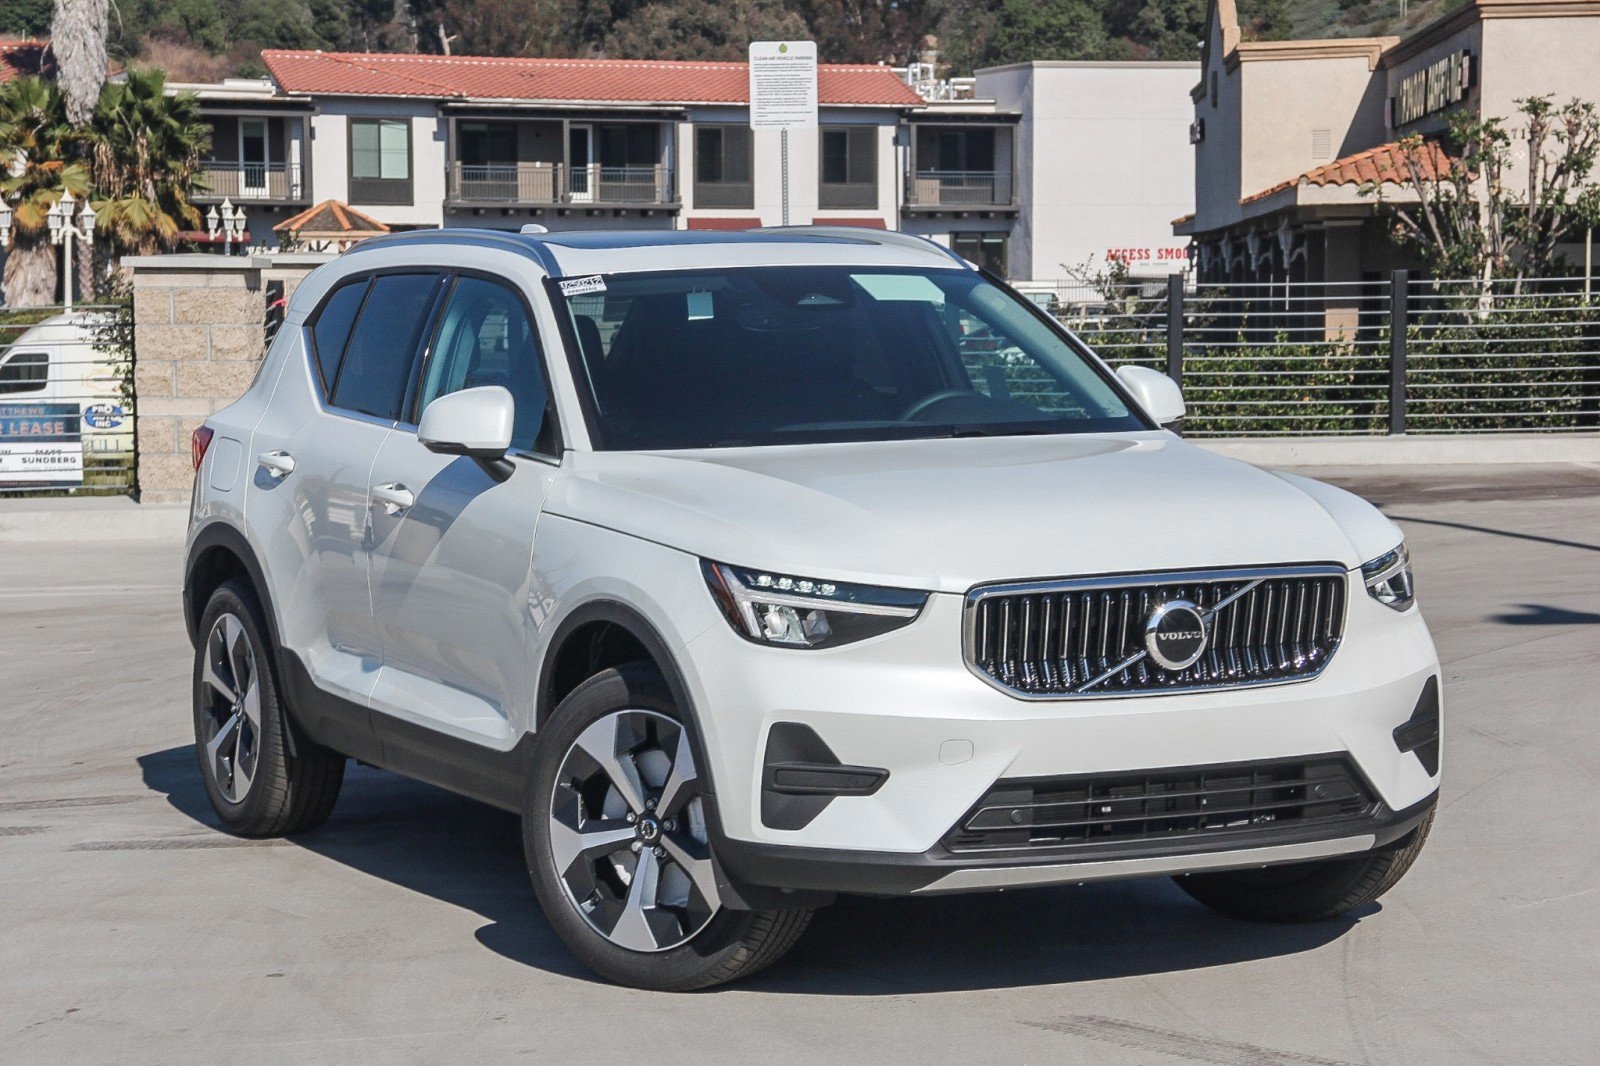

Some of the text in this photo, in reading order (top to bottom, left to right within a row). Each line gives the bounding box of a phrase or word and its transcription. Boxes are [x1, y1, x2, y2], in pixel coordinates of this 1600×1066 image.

[1107, 249, 1151, 260] ACCESS
[10, 421, 64, 435] LEASE
[1157, 631, 1202, 640] VOLVO
